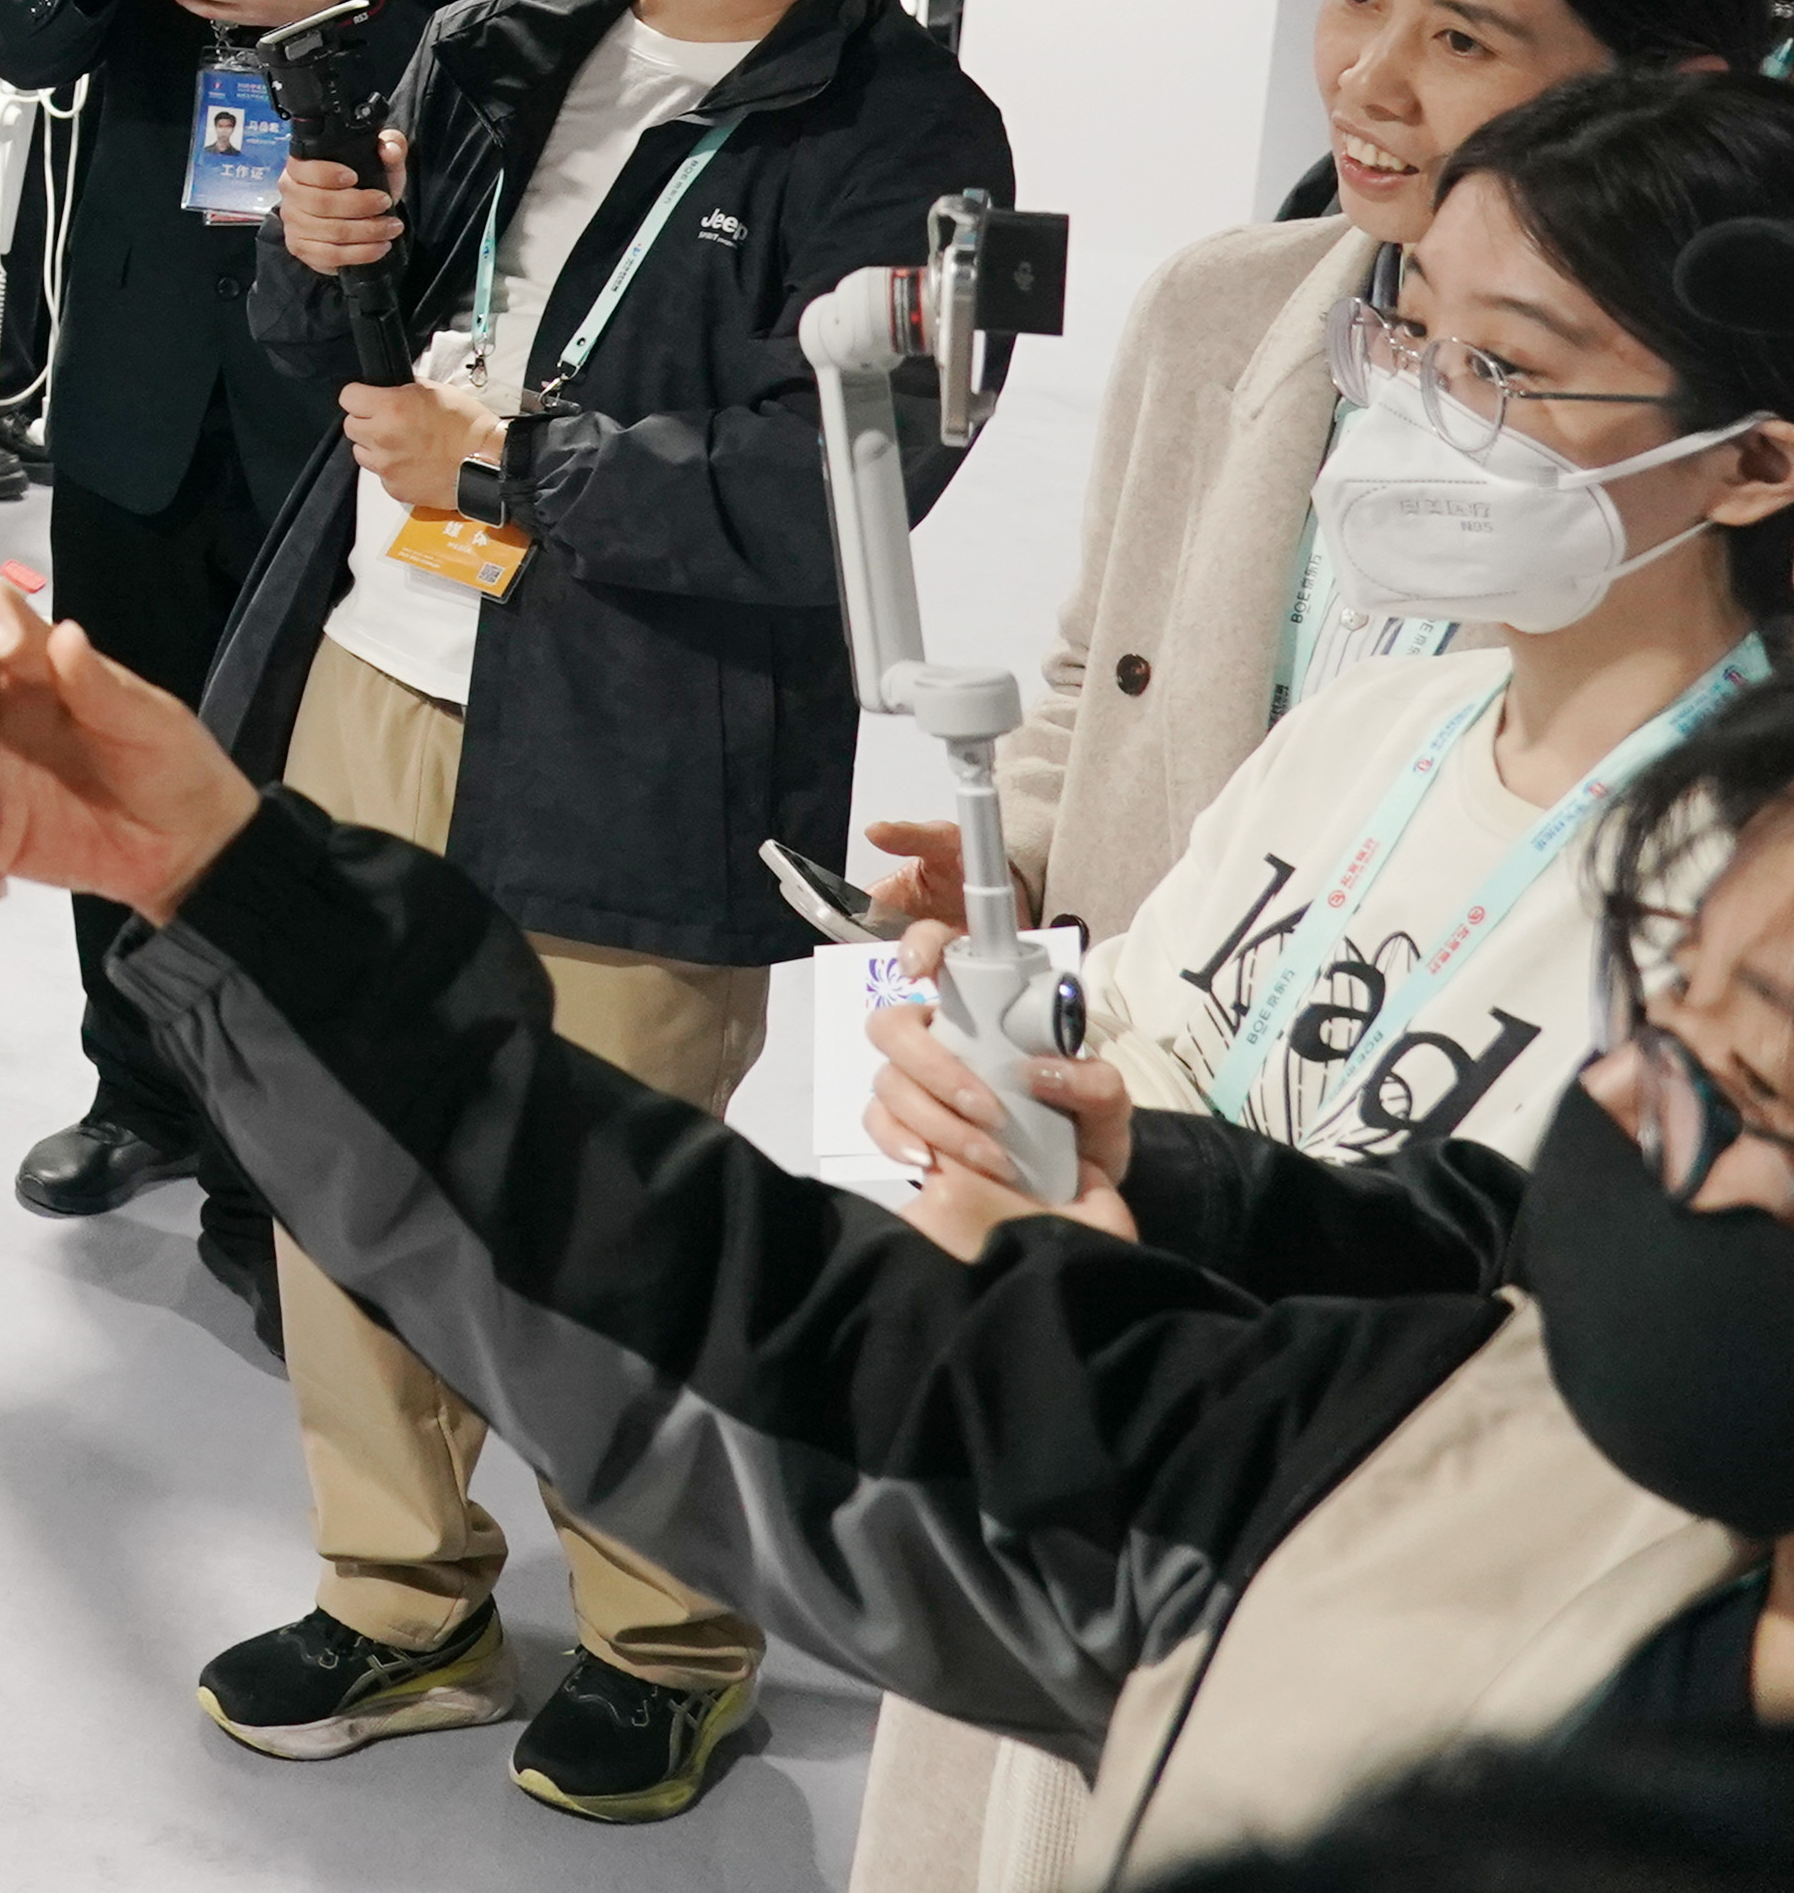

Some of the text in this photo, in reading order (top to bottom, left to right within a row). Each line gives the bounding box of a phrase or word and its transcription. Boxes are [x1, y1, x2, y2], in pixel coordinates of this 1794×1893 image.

[701, 208, 748, 240] Jeep
[1290, 591, 1311, 624] BOE
[1247, 969, 1296, 1045] BOE 京东方
